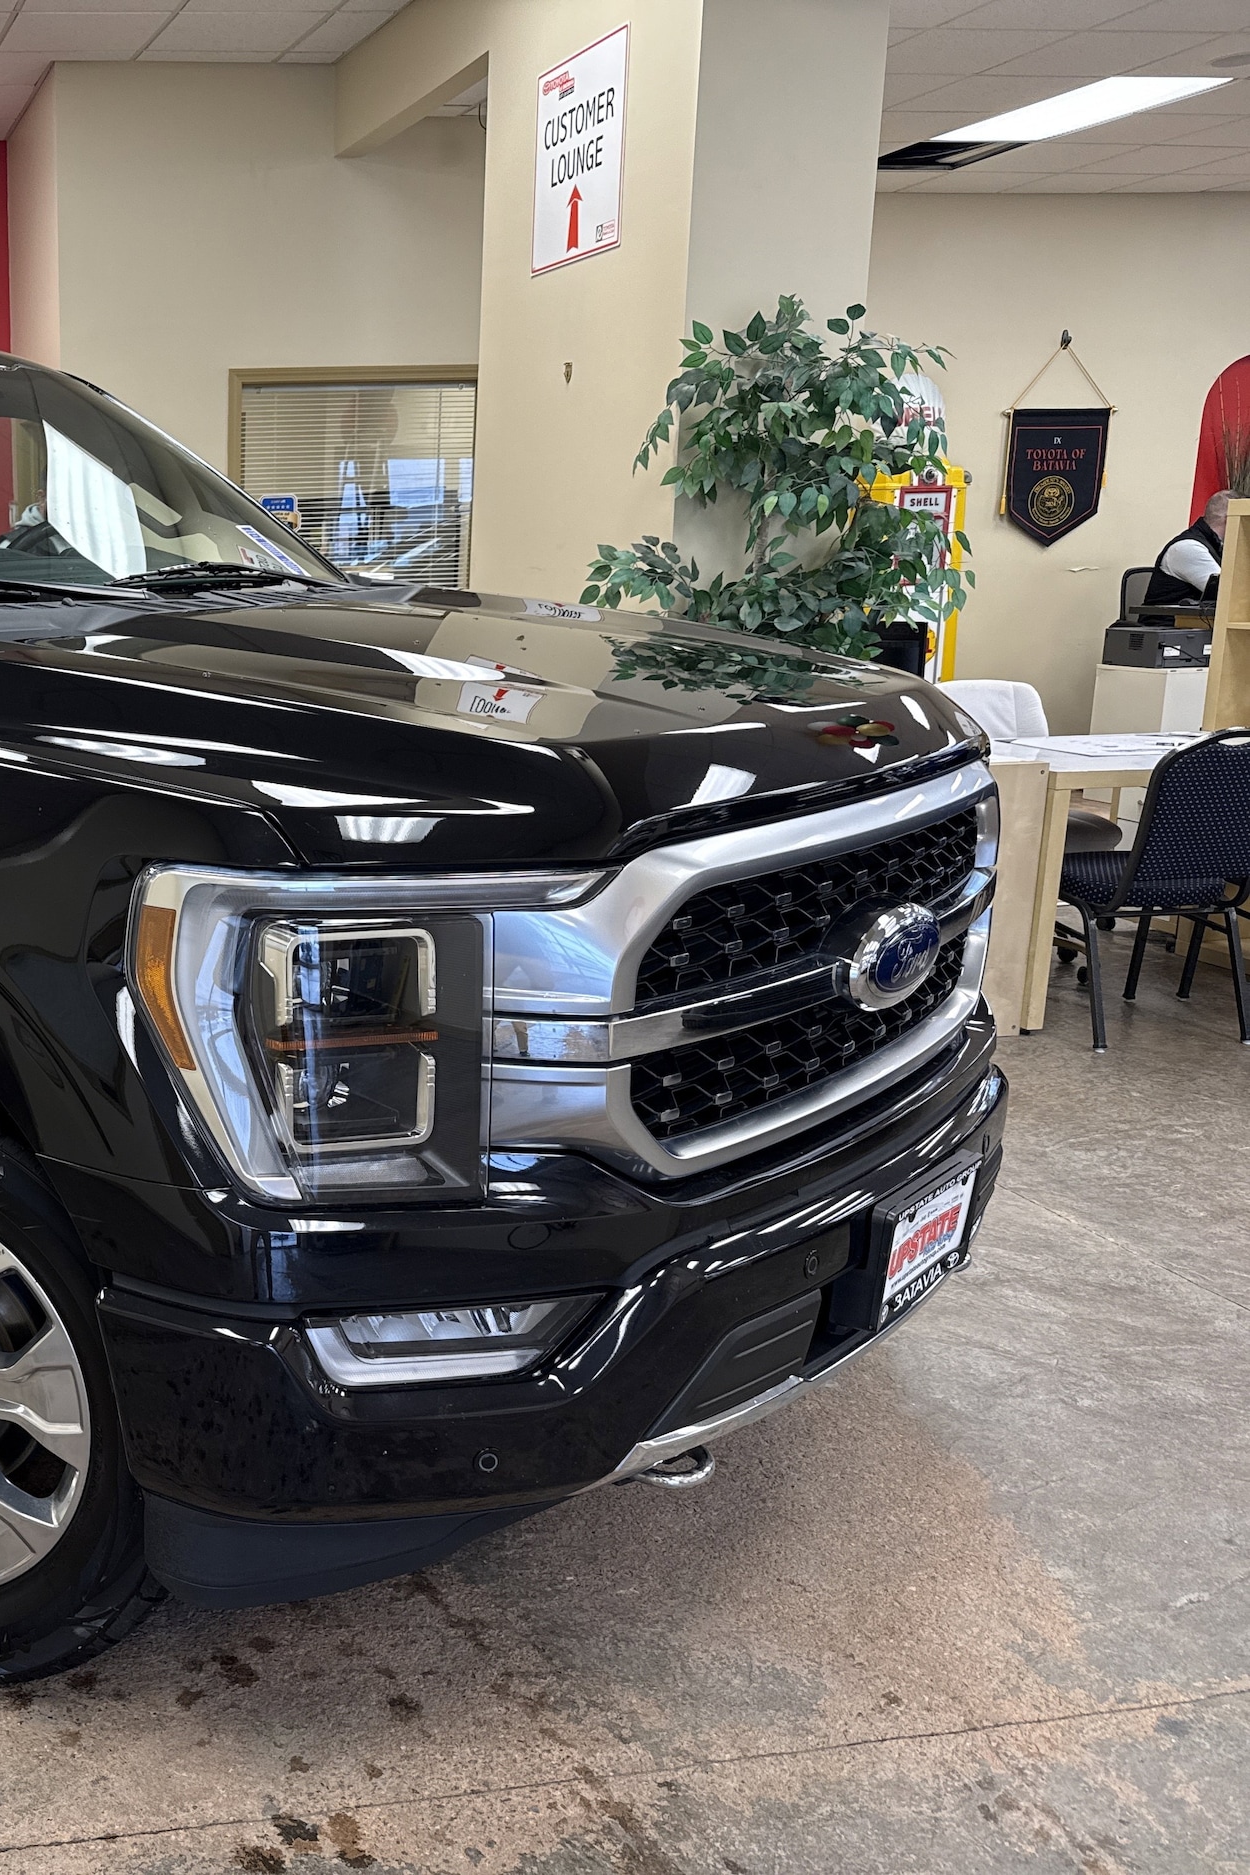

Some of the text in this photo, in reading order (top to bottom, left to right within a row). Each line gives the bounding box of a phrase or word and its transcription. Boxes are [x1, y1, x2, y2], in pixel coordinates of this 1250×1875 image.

[544, 87, 615, 151] CUSTOMER
[551, 134, 604, 188] LOUNGE
[1026, 448, 1087, 460] TOYOTA OF
[1033, 460, 1077, 471] BATAVIA
[1053, 436, 1062, 445] IX
[909, 497, 940, 507] SHELL
[890, 932, 933, 984] Ford
[898, 1191, 934, 1221] UPSTATE
[934, 1178, 956, 1197] AUTO
[956, 1160, 983, 1182] GROUP
[888, 1202, 963, 1279] UPSTATE
